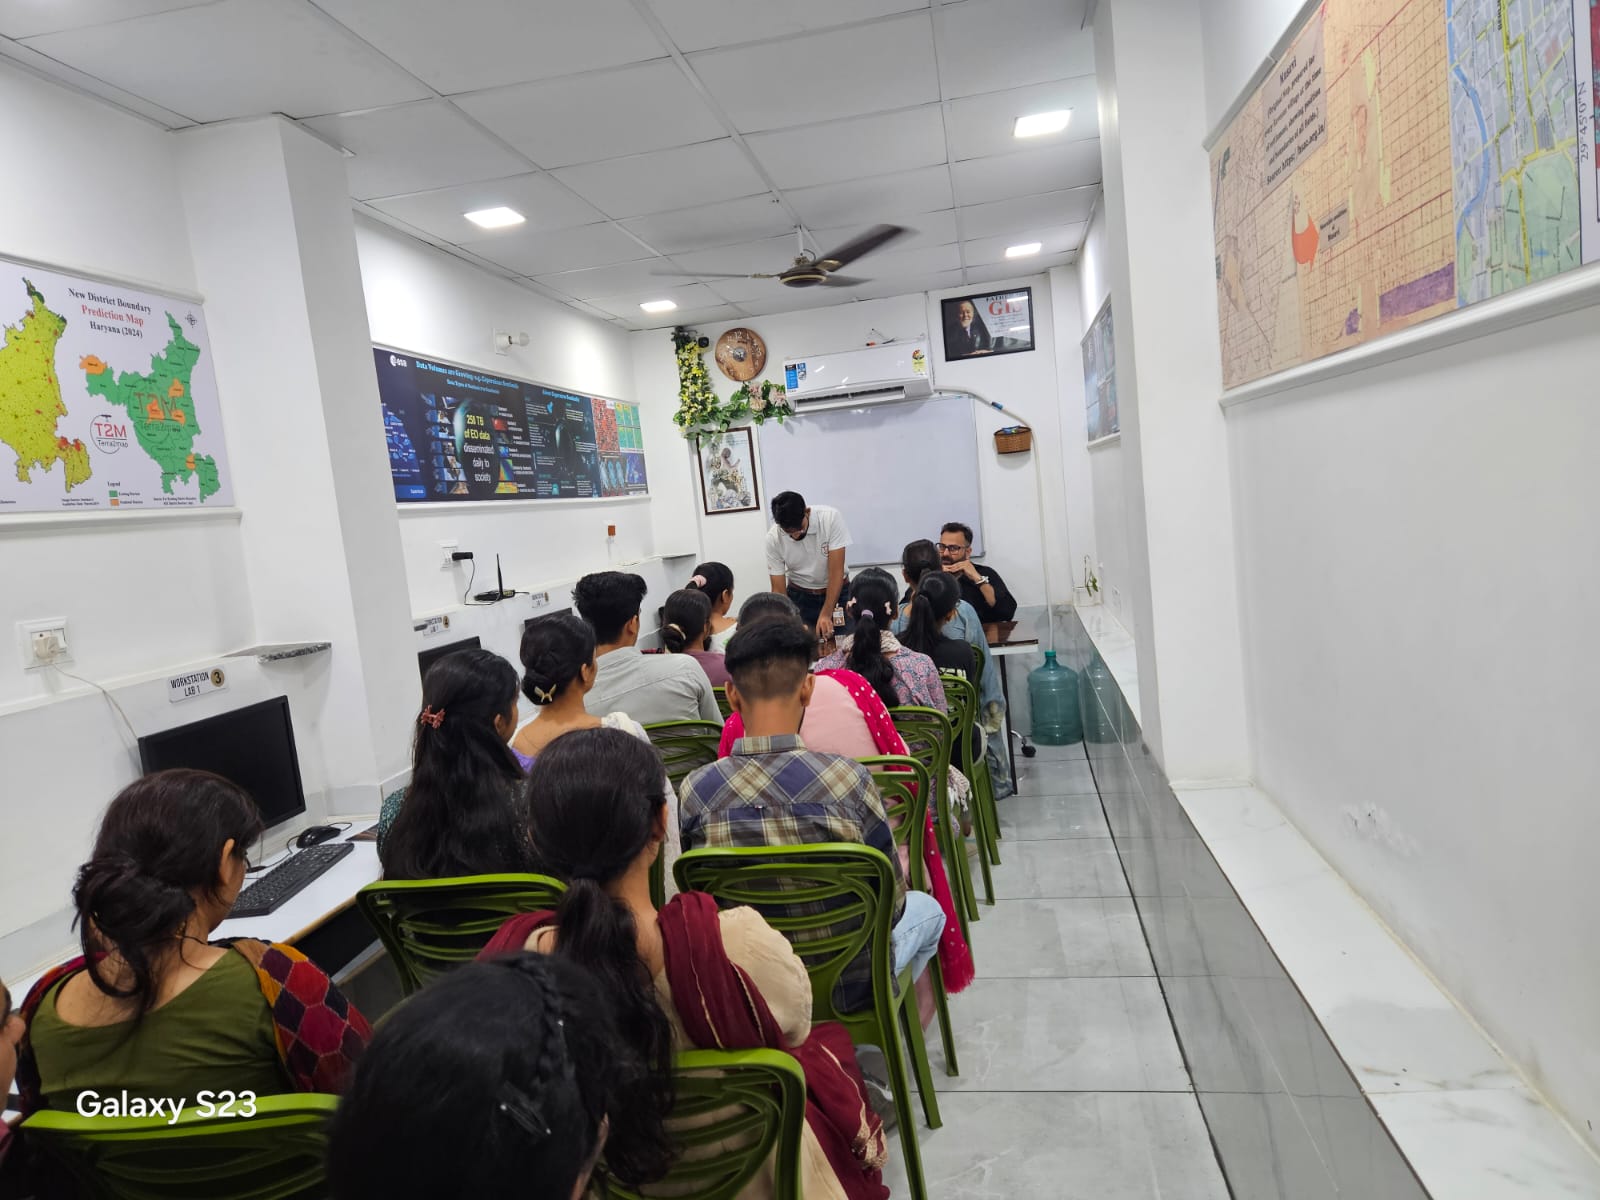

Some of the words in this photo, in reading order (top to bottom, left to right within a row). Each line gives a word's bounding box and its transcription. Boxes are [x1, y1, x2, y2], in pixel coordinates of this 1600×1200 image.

[68, 287, 86, 300] New
[87, 292, 116, 307] District
[117, 298, 152, 316] Boundary
[81, 304, 125, 322] Prediction
[125, 313, 144, 328] Map
[89, 320, 121, 334] Haryana
[121, 327, 144, 340] (2024)
[415, 360, 428, 370] Data
[428, 364, 447, 375] Volumes
[476, 415, 484, 426] TB
[94, 422, 127, 438] T2M
[464, 428, 470, 439] of
[470, 429, 479, 439] EO
[479, 430, 491, 441] data
[463, 443, 495, 454] disseminated
[472, 457, 483, 470] daily
[484, 459, 490, 468] to
[474, 472, 491, 484] society
[170, 671, 210, 689] WORKSTATION
[184, 685, 196, 697] LAB
